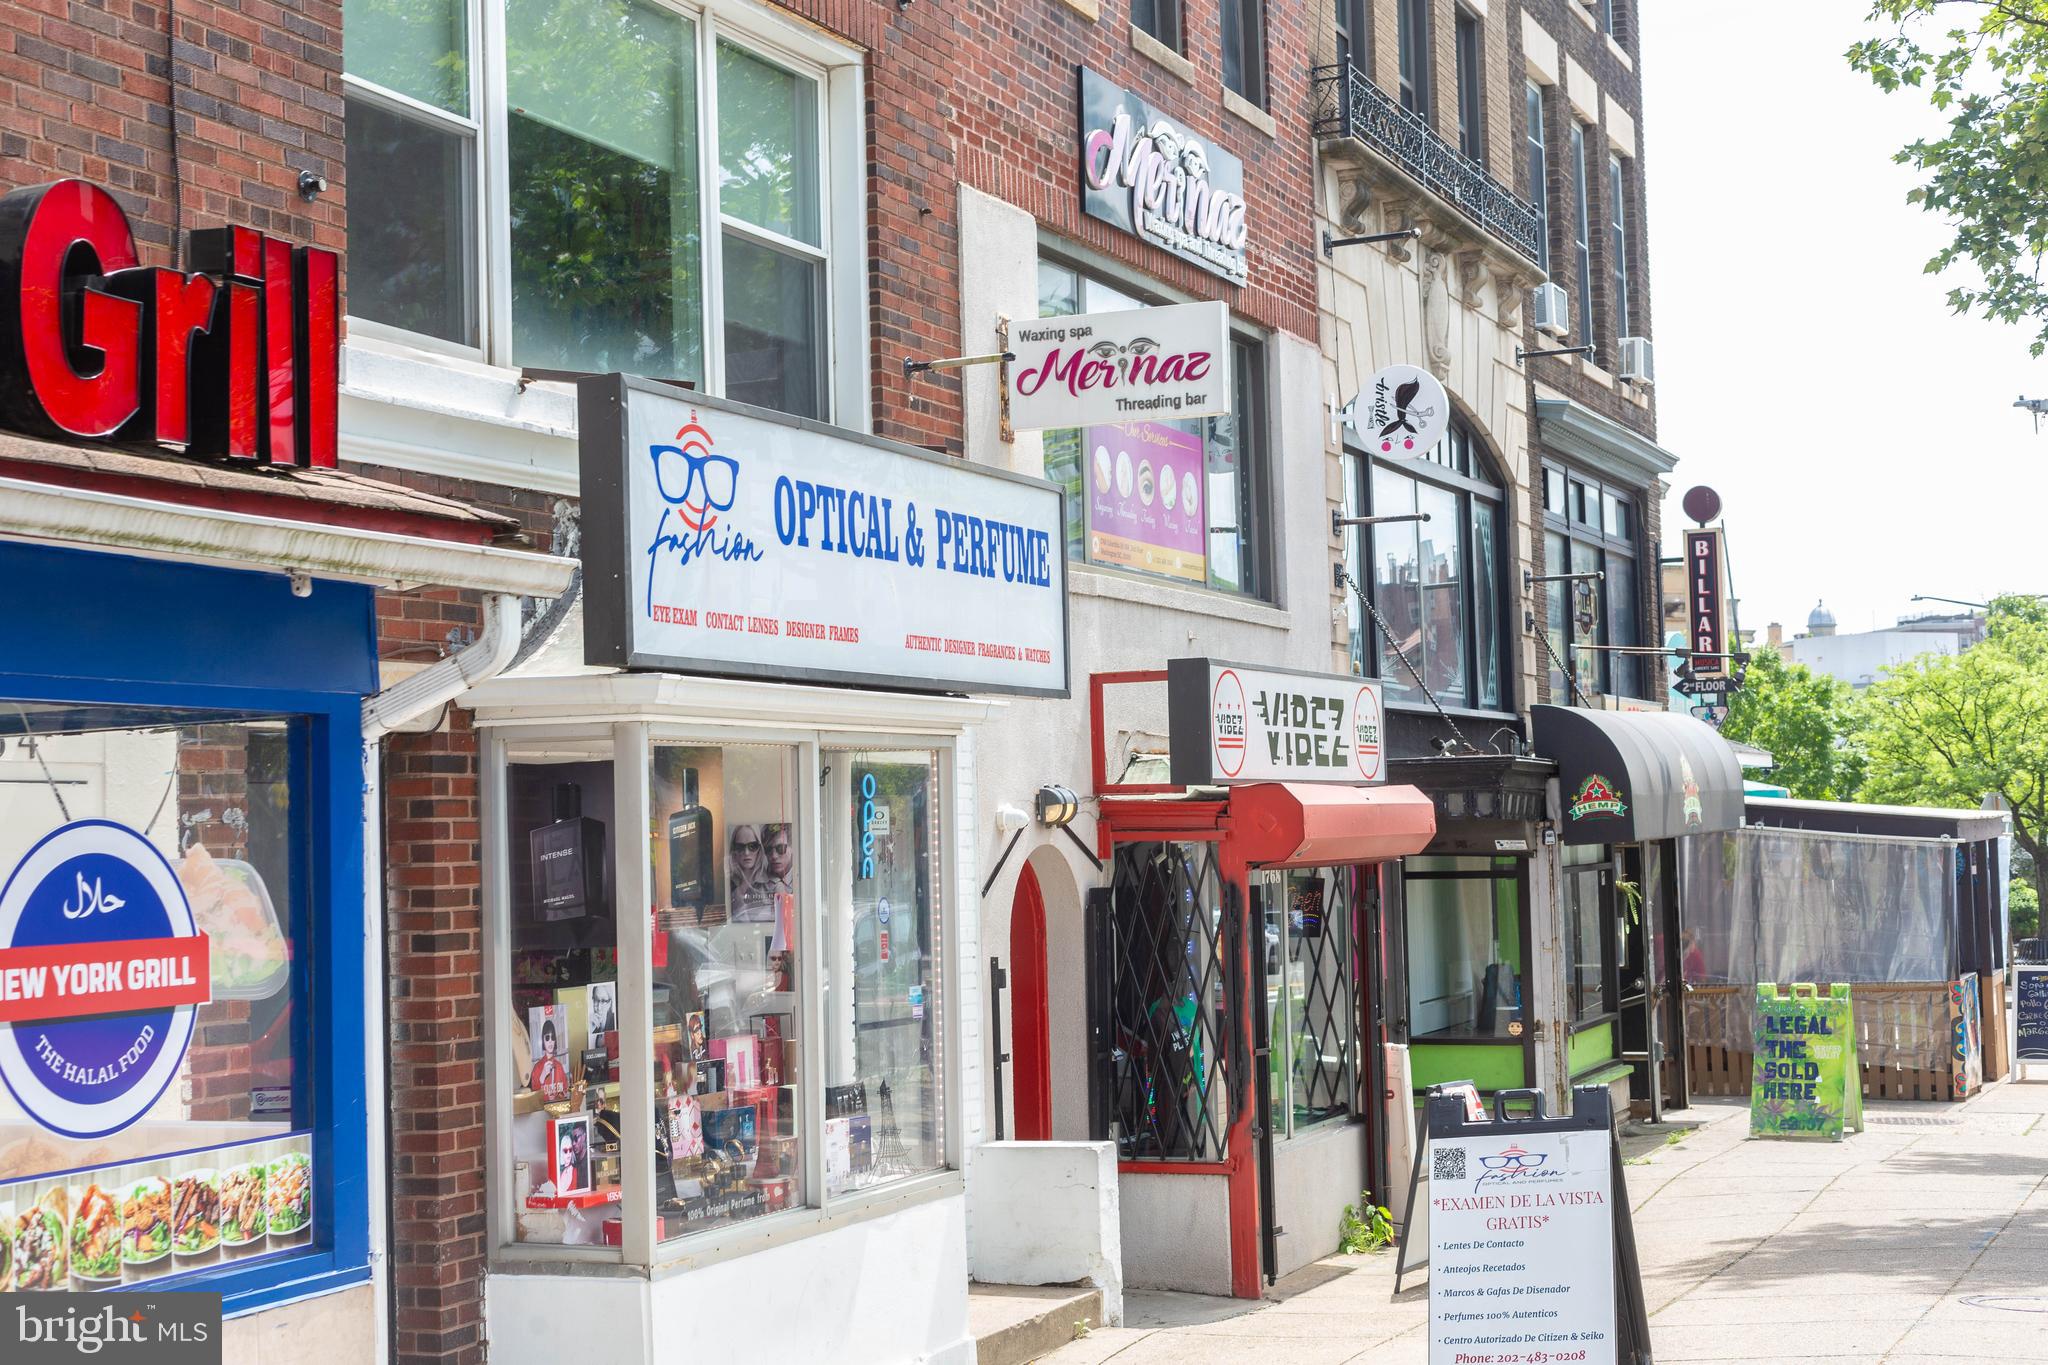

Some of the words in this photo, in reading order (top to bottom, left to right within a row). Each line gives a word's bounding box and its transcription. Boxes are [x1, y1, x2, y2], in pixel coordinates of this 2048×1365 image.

[20, 178, 339, 470] Grill
[1019, 327, 1065, 343] Waxing
[1070, 325, 1093, 339] spa
[1016, 348, 1212, 398] Merinaz
[1116, 394, 1182, 412] Threading
[1185, 392, 1208, 406] bar
[774, 475, 900, 562] OPTICAL
[905, 502, 925, 568] &
[935, 508, 1051, 588] PERFUME
[648, 496, 764, 618] fashion
[1694, 540, 1714, 653] BILLAR
[652, 605, 671, 624] EYE
[672, 606, 697, 626] EXAM
[706, 611, 744, 632] CONTACT
[747, 616, 779, 636] LENSES
[786, 620, 826, 640] DESIGNER
[828, 625, 859, 644] FRAMES
[905, 634, 942, 652] AUTHENTIC
[944, 639, 976, 656] DESIGNER
[978, 642, 1016, 660] FRAGRANCES
[1018, 647, 1023, 661] &
[1025, 647, 1051, 664] WATCHES
[1695, 680, 1726, 692] FLOOR
[1577, 801, 1621, 814] HEMP
[540, 847, 574, 862] INTENSE
[1262, 869, 1281, 884] 1768
[63, 871, 126, 919] حلال
[52, 960, 124, 997] YORK
[127, 956, 197, 990] GRILL
[1766, 1016, 1833, 1035] LEGAL
[35, 1034, 65, 1074] THE
[62, 1062, 119, 1085] HALAL
[118, 1024, 155, 1073] FOOD
[1764, 1062, 1819, 1081] SOLD
[1763, 1082, 1817, 1100] HERE
[1474, 1164, 1568, 1194] fashion
[706, 1200, 730, 1217] Original
[1510, 1194, 1532, 1209] DE
[1536, 1193, 1555, 1207] LA
[1558, 1191, 1604, 1206] VISTA
[1443, 1242, 1471, 1250] Lentes
[1473, 1241, 1485, 1249] De
[1486, 1239, 1525, 1249] Contacto
[1443, 1264, 1481, 1275] Anteojos
[1482, 1262, 1526, 1273] Recetados
[1443, 1288, 1475, 1297] Marcos
[1477, 1287, 1485, 1296] &
[1486, 1286, 1511, 1298] Gafas
[1512, 1286, 1524, 1295] De
[1526, 1284, 1571, 1295] Disenador
[1443, 1312, 1484, 1323] Perfumes
[1486, 1311, 1510, 1320] 100%
[1512, 1309, 1558, 1319] Autenticos
[1443, 1335, 1473, 1345] Centro
[1474, 1333, 1523, 1344] Autorizado
[1524, 1333, 1536, 1342] De
[1537, 1332, 1569, 1342] Citizen
[1570, 1332, 1578, 1341] &
[1580, 1331, 1605, 1340] Seiko
[1455, 1352, 1494, 1365] Phone:
[1497, 1350, 1586, 1364] 202-483-0208
